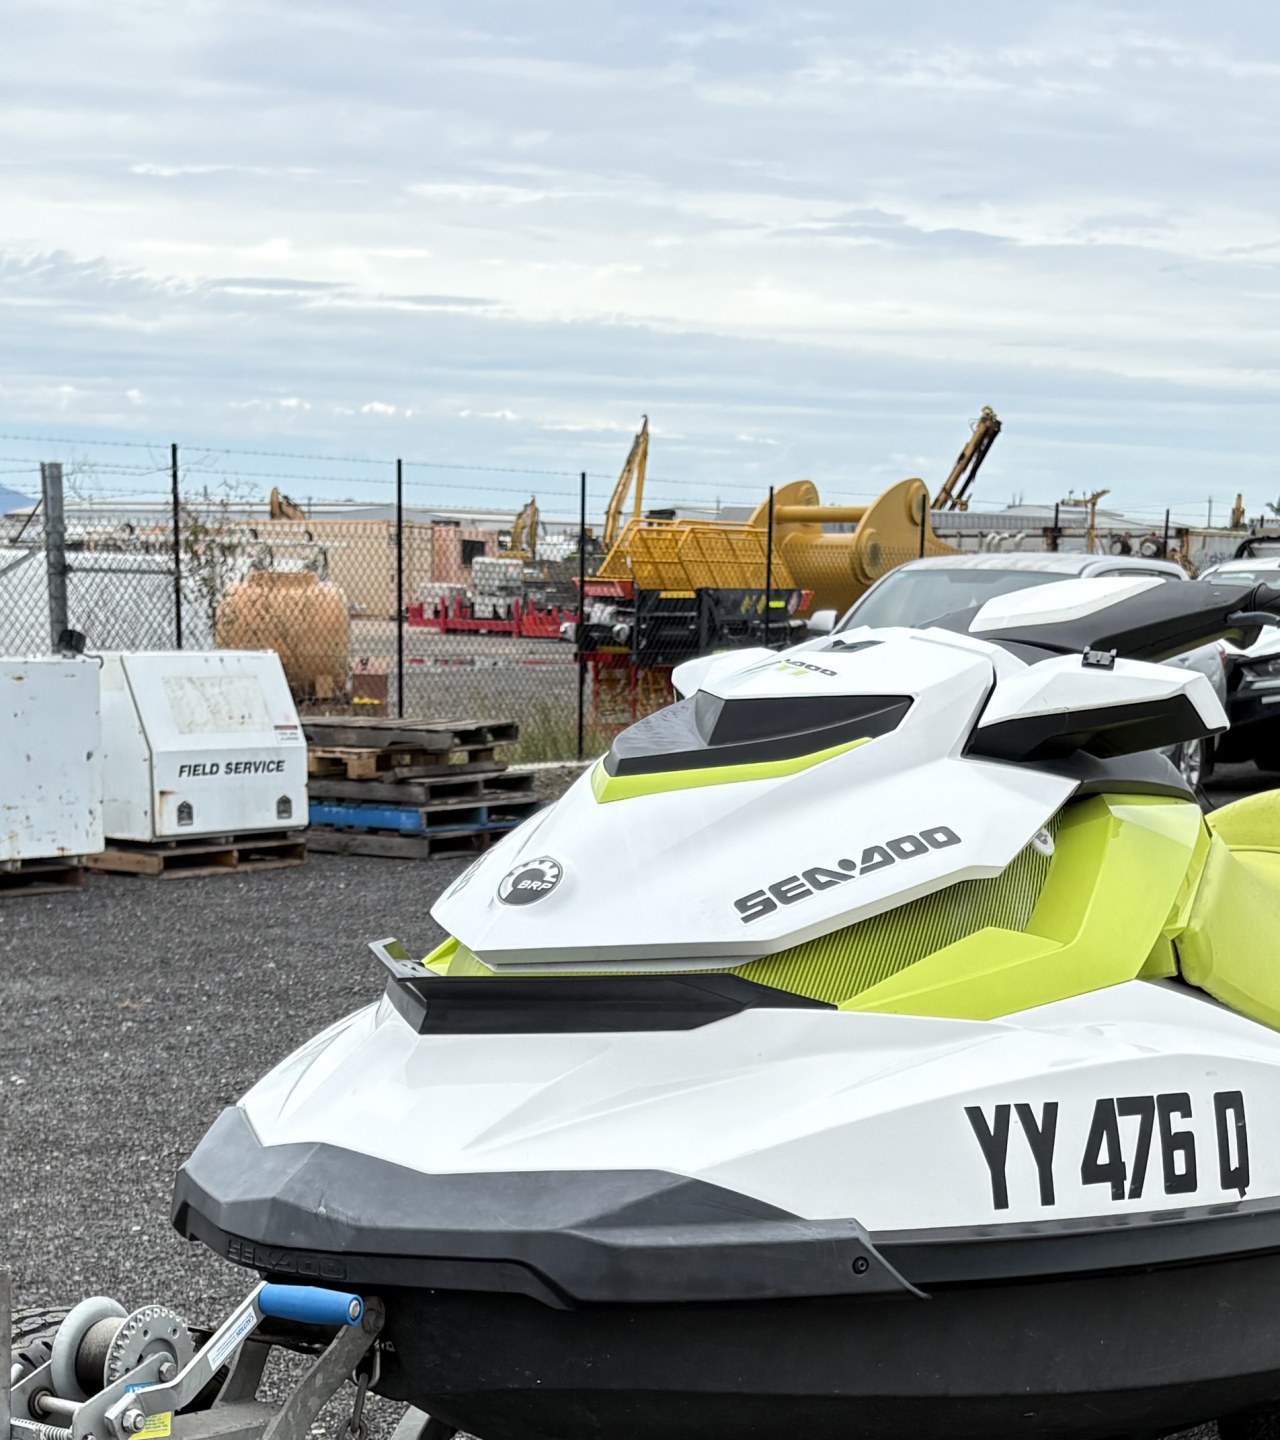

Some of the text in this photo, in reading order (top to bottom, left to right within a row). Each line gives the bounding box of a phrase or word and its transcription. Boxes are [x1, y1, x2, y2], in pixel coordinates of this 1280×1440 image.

[178, 760, 285, 778] FIELD SERVICE
[516, 879, 553, 891] BRP
[964, 1090, 1250, 1211] YY 476 Q
